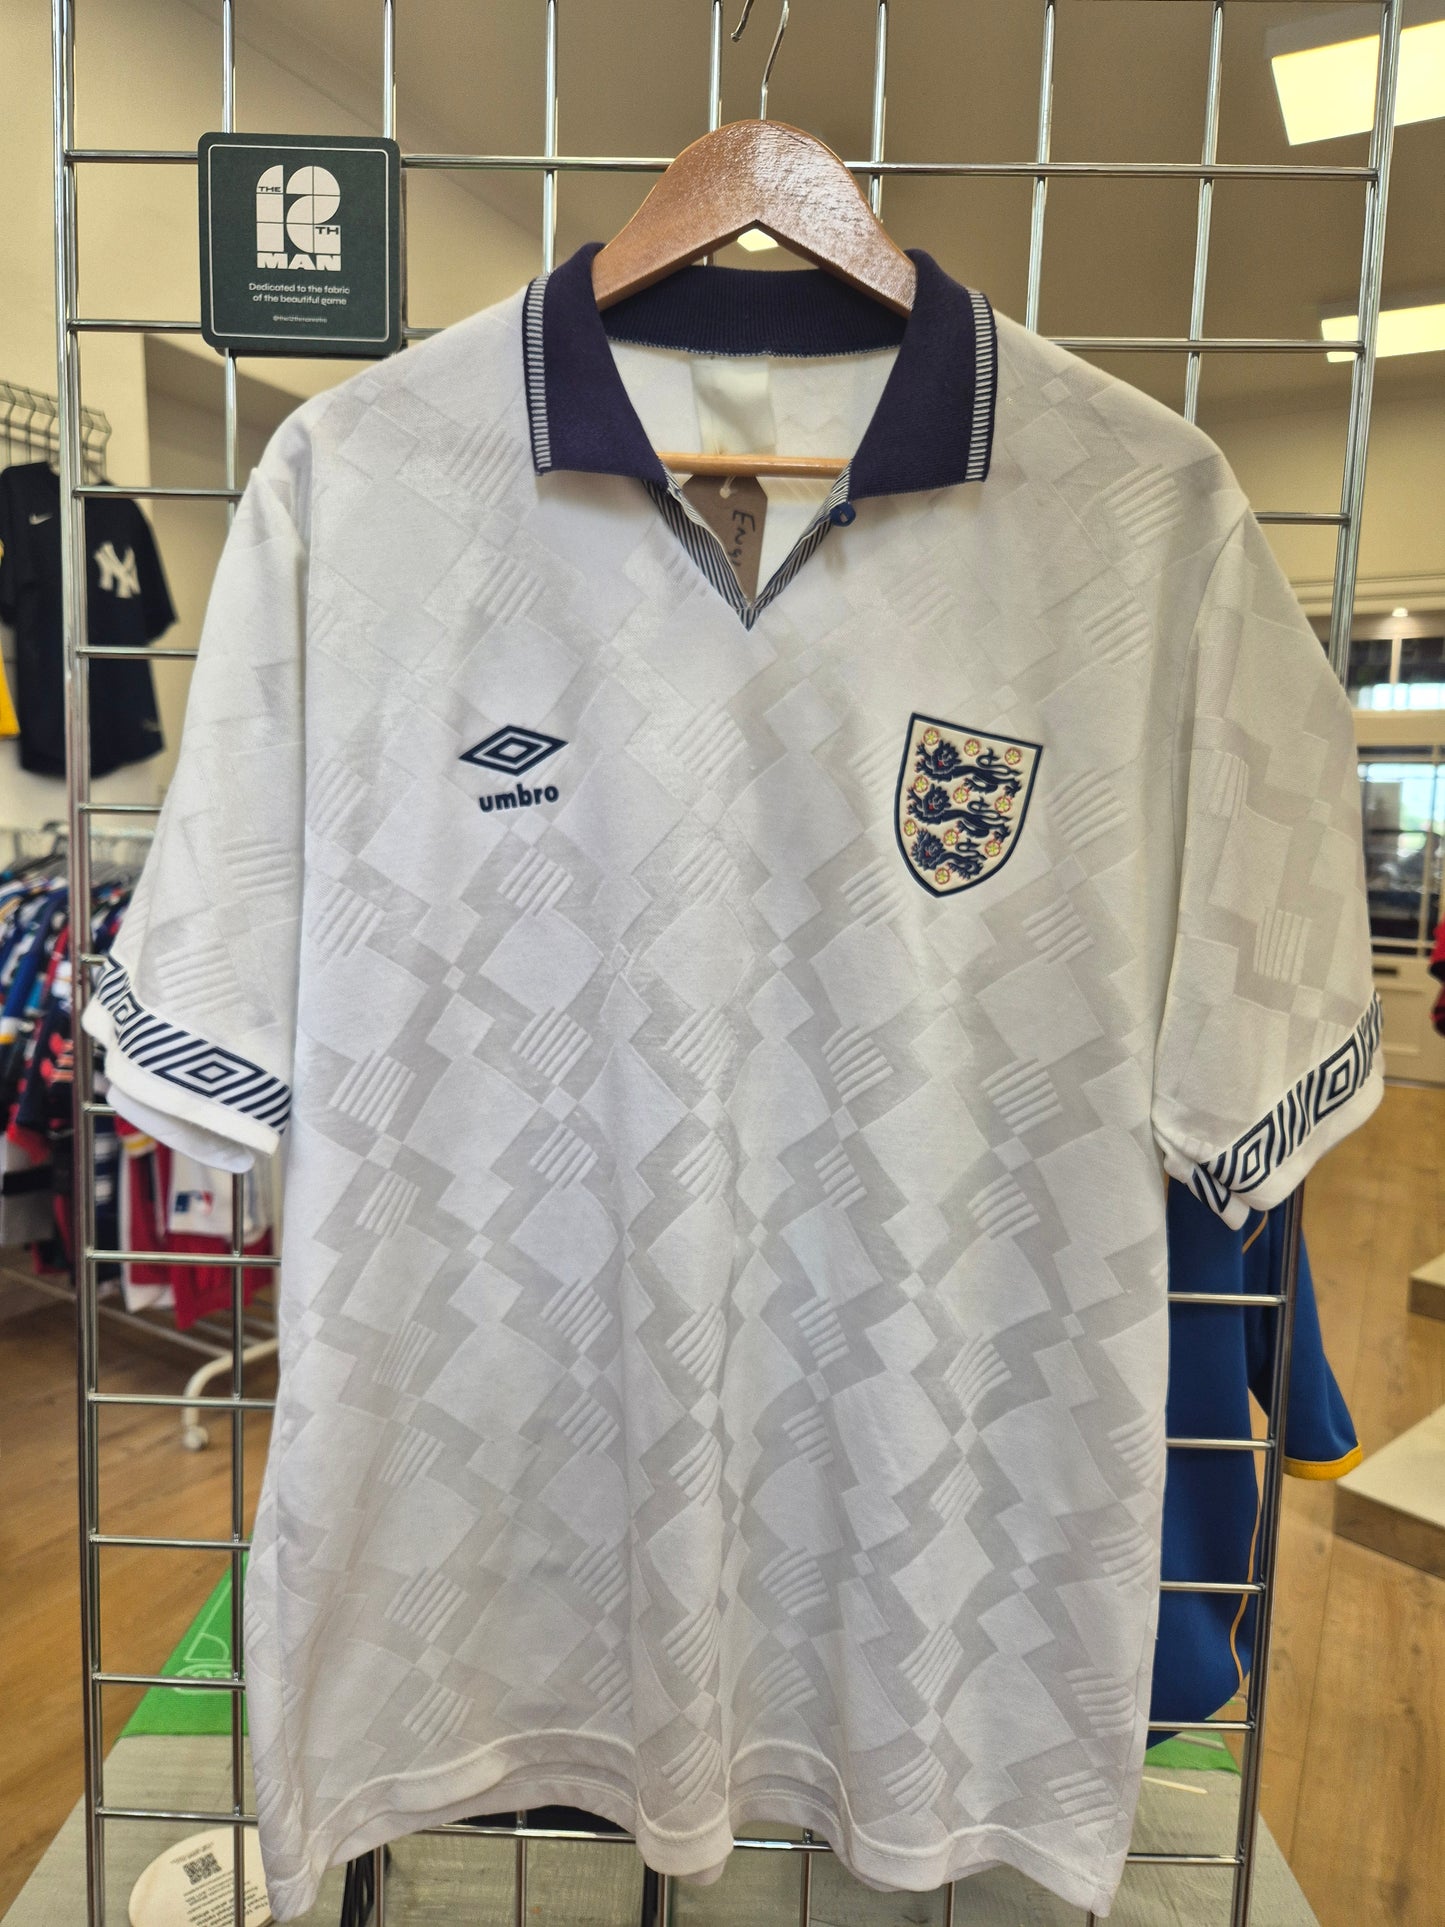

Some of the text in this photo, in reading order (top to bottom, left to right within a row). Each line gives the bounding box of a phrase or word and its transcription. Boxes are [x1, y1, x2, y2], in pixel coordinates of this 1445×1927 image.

[315, 226, 339, 235] TH
[256, 252, 341, 271] MAN
[248, 282, 295, 292] Dedicated
[307, 285, 323, 293] the
[324, 286, 350, 295] fabric
[252, 294, 347, 306] of the beautiful game
[94, 541, 141, 599] NY
[479, 782, 559, 813] umbro
